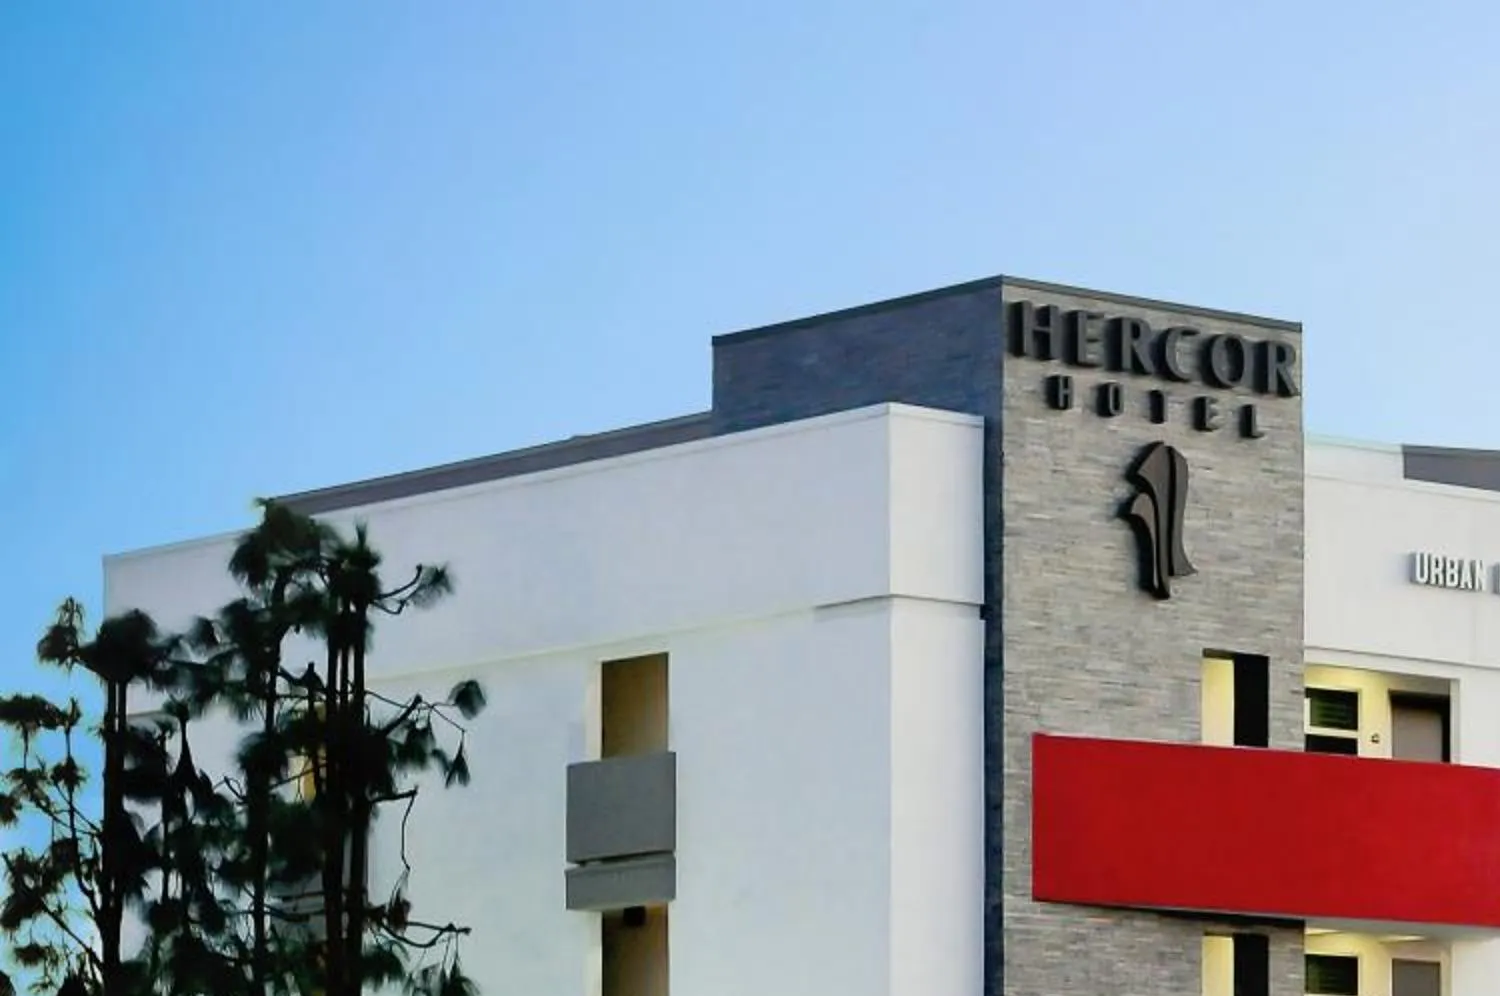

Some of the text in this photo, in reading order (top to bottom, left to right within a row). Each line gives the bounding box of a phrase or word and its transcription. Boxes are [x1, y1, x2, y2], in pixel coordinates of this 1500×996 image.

[1007, 300, 1299, 397] HERCOR
[1045, 374, 1264, 439] HOTEL
[1409, 551, 1486, 592] URBAN
